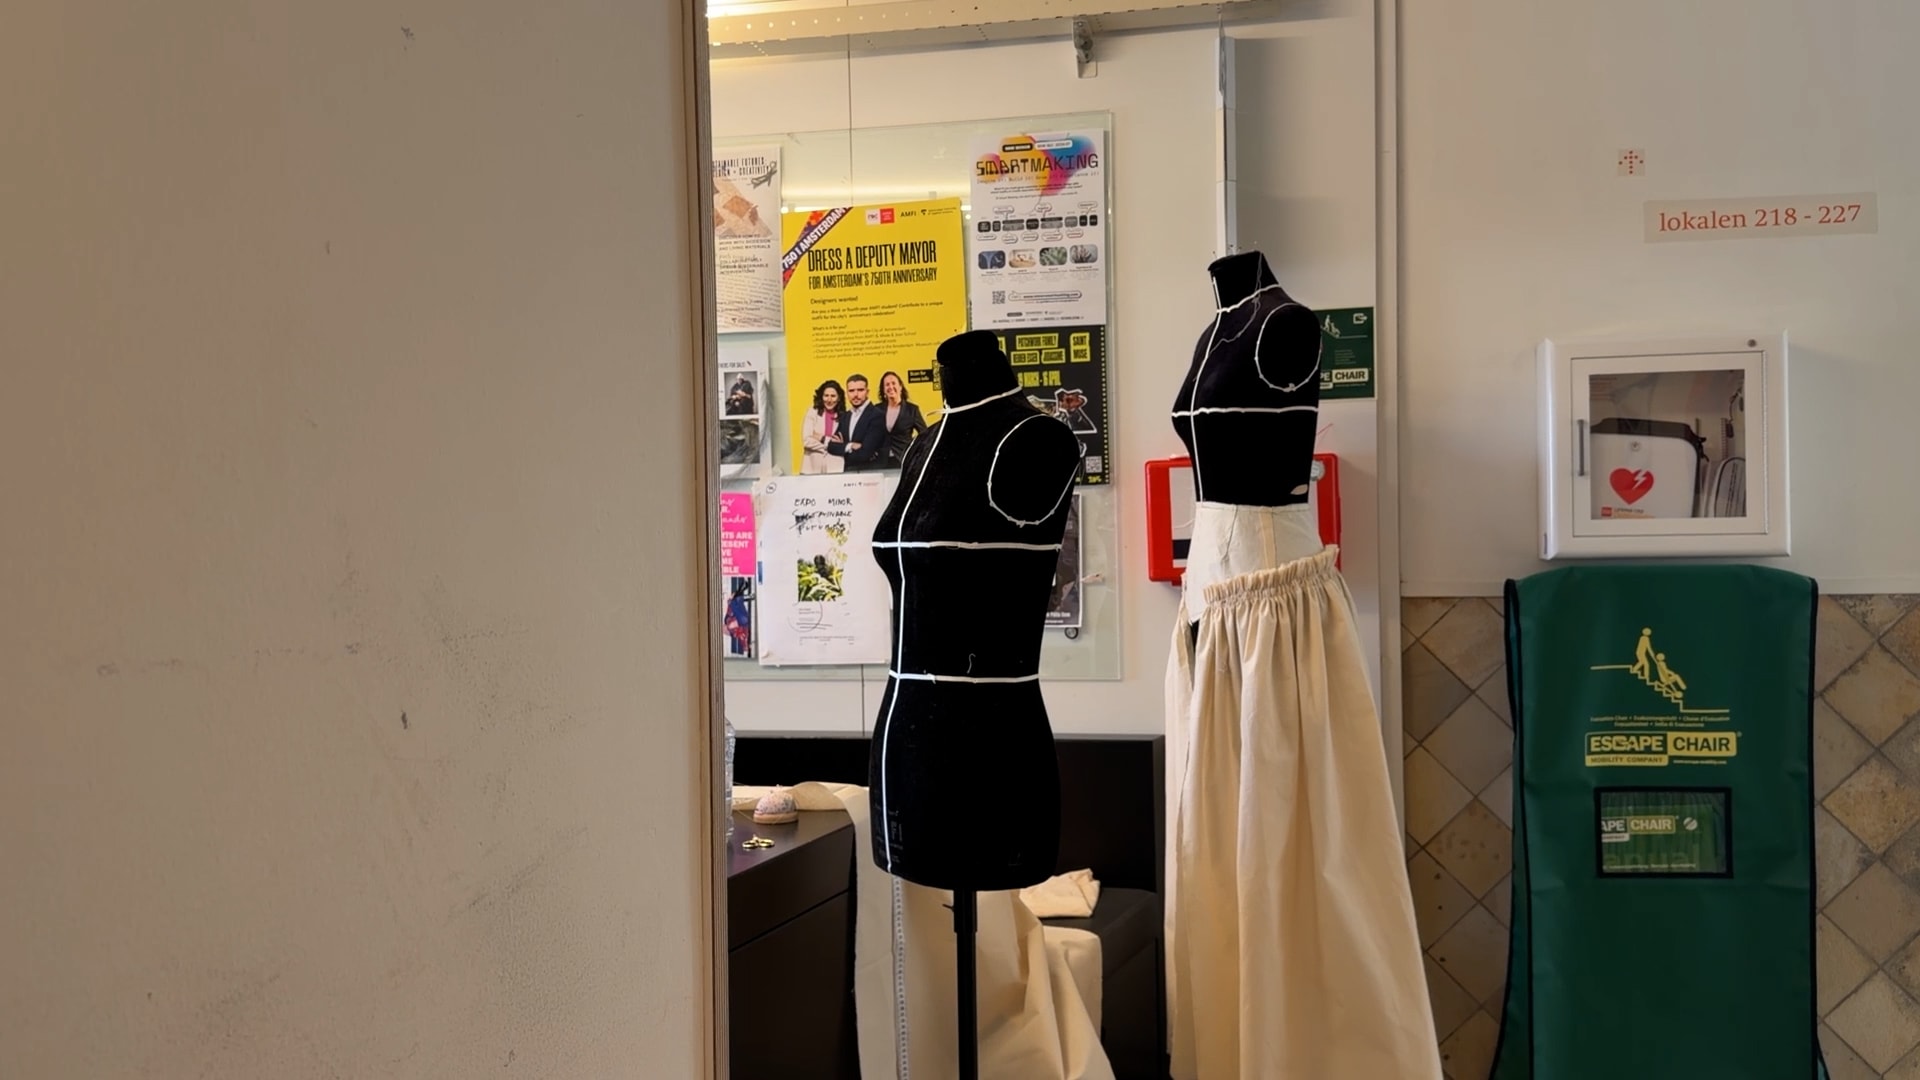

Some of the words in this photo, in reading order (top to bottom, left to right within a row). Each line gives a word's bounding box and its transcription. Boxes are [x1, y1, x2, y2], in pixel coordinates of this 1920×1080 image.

[976, 154, 1098, 176] SMARTMAKING
[1659, 210, 1747, 232] lokalen
[1754, 207, 1797, 228] 218
[1818, 204, 1861, 224] 227
[782, 252, 798, 268] 750
[799, 208, 846, 252] AMSTERDAM
[808, 248, 842, 272] DRESS
[846, 246, 853, 269] A
[856, 244, 896, 268] DEPUTY
[900, 240, 937, 265] MAYOR
[808, 275, 821, 290] FOR
[823, 273, 869, 289] AMSTERDAM'S
[870, 271, 891, 286] 750TH
[893, 267, 937, 284] ANNIVERSARY
[810, 297, 837, 305] Designers
[1334, 371, 1365, 380] CHAIR
[794, 498, 816, 506] EXPO
[828, 497, 853, 506] MINOR
[736, 531, 752, 539] ARE
[1590, 736, 1664, 751] ESCAPE
[1673, 737, 1730, 752] CHAIR
[1630, 819, 1672, 830] CHAIR
